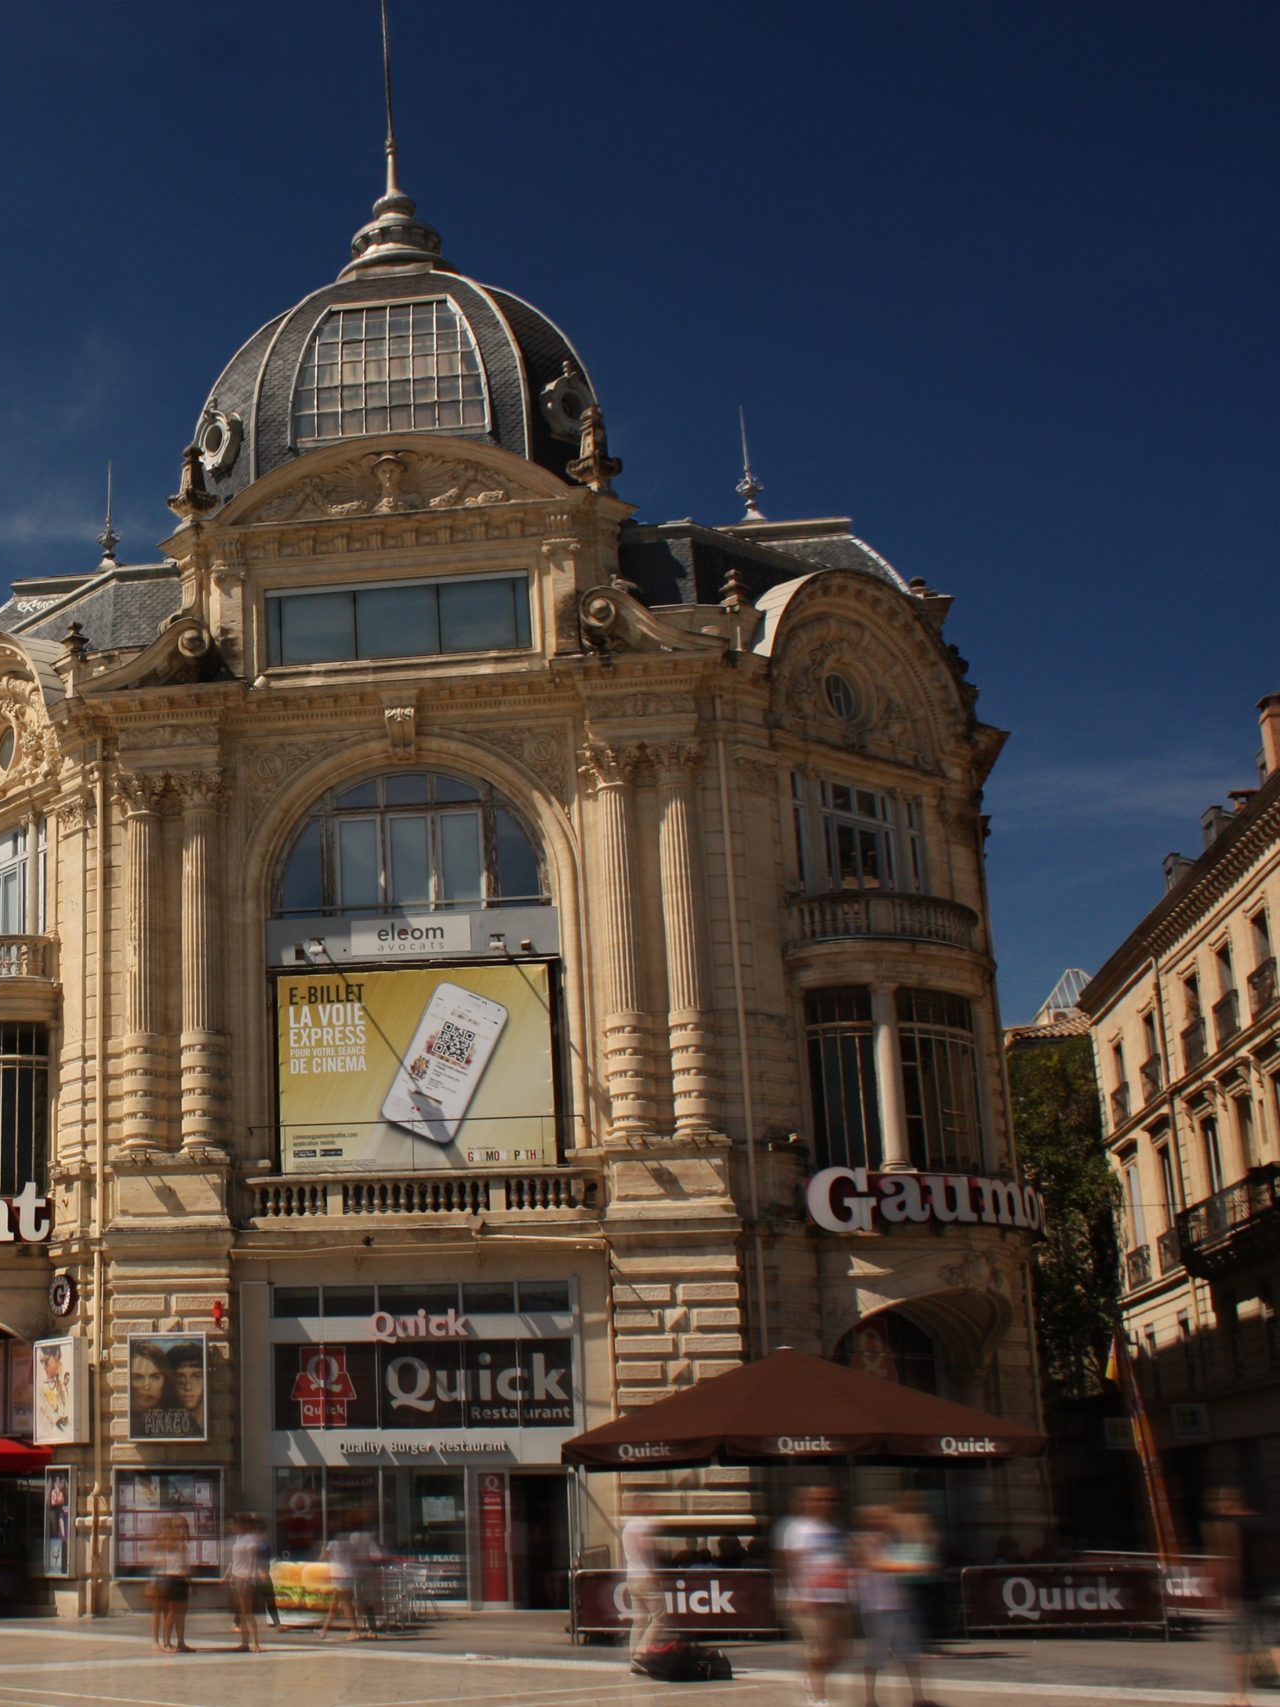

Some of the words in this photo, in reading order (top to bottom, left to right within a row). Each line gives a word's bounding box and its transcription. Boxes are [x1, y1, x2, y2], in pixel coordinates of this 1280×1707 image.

[377, 922, 444, 942] eleom
[377, 941, 444, 952] avocats
[289, 983, 365, 1005] E-BILLET
[289, 1005, 312, 1028] LA
[318, 1002, 366, 1026] VOIE
[289, 1026, 367, 1048] EXPRESS
[290, 1048, 310, 1057] POUR
[312, 1047, 335, 1056] VOTRE
[290, 1057, 309, 1075] DE
[368, 1308, 469, 1344] Quick
[306, 1354, 343, 1392] Q
[385, 1351, 569, 1413] Quick
[471, 1405, 571, 1420] Restaurant
[339, 1441, 383, 1456] Quality
[390, 1441, 432, 1455] Burger
[439, 1440, 507, 1453] Restaurant
[618, 1442, 671, 1461] Quick
[777, 1436, 833, 1455] Quick
[940, 1437, 997, 1456] Quick
[418, 1554, 430, 1562] LA
[433, 1554, 460, 1562] PLACE
[613, 1580, 736, 1621] Qick
[1002, 1575, 1124, 1620] Quick
